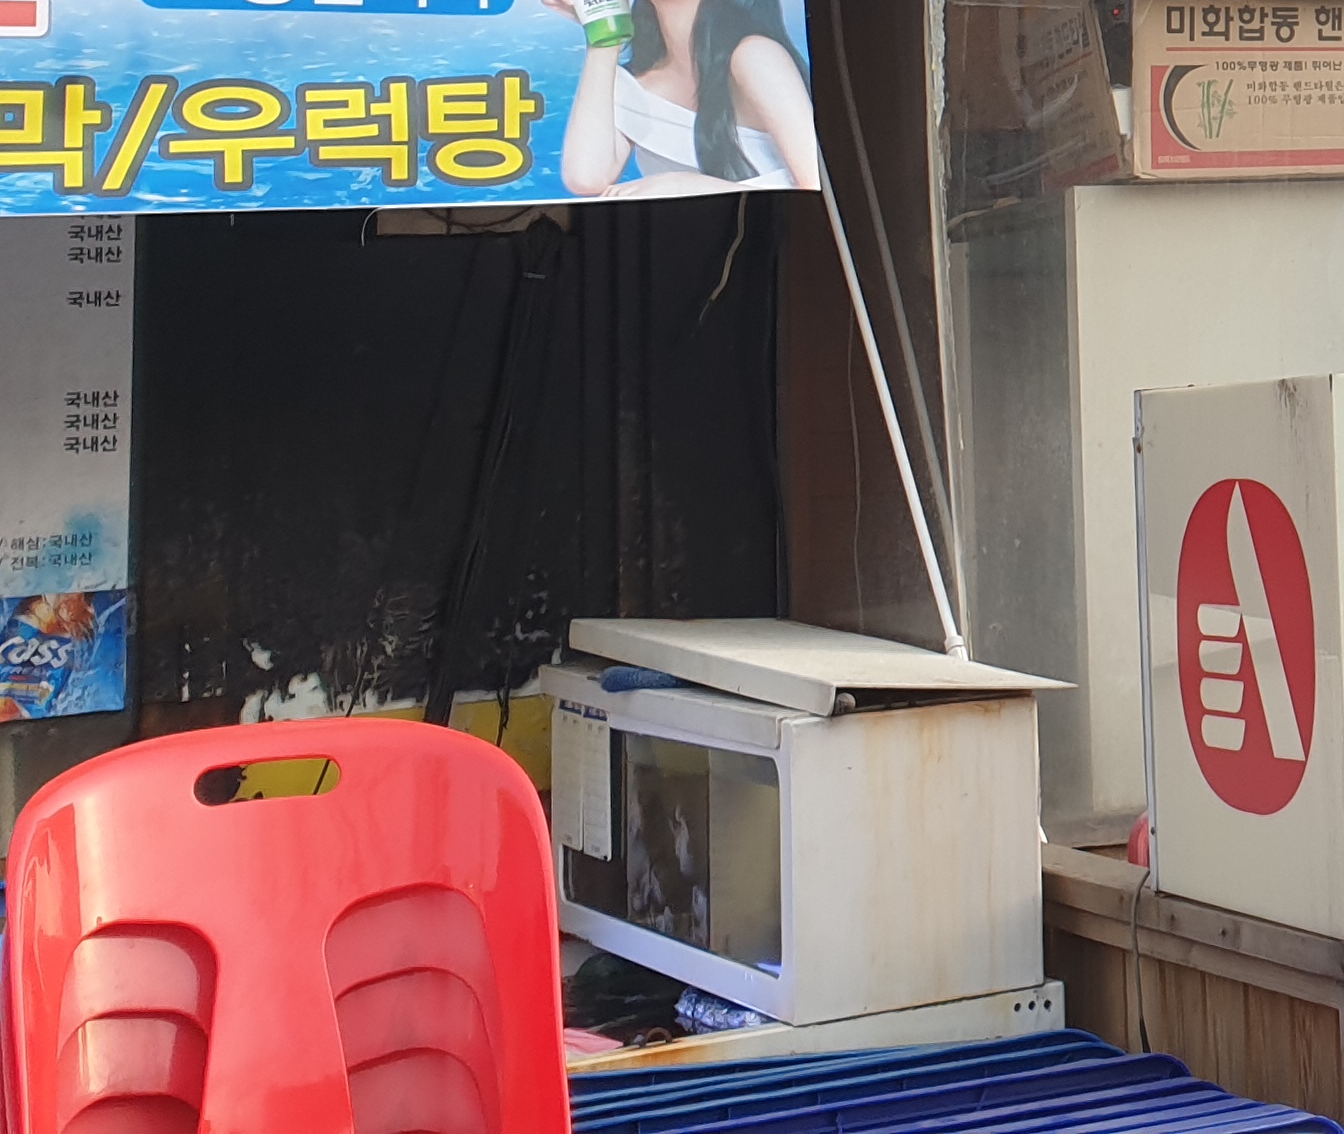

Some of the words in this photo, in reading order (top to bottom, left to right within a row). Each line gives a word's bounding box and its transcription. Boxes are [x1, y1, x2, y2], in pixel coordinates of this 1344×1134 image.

[1166, 5, 1300, 44] 미화합동
[67, 224, 123, 243] 국내산
[67, 246, 123, 265] 국내산
[66, 289, 122, 309] 국내산
[63, 390, 120, 410] 국내산
[62, 412, 119, 431] 국내산
[62, 434, 118, 454] 국내산
